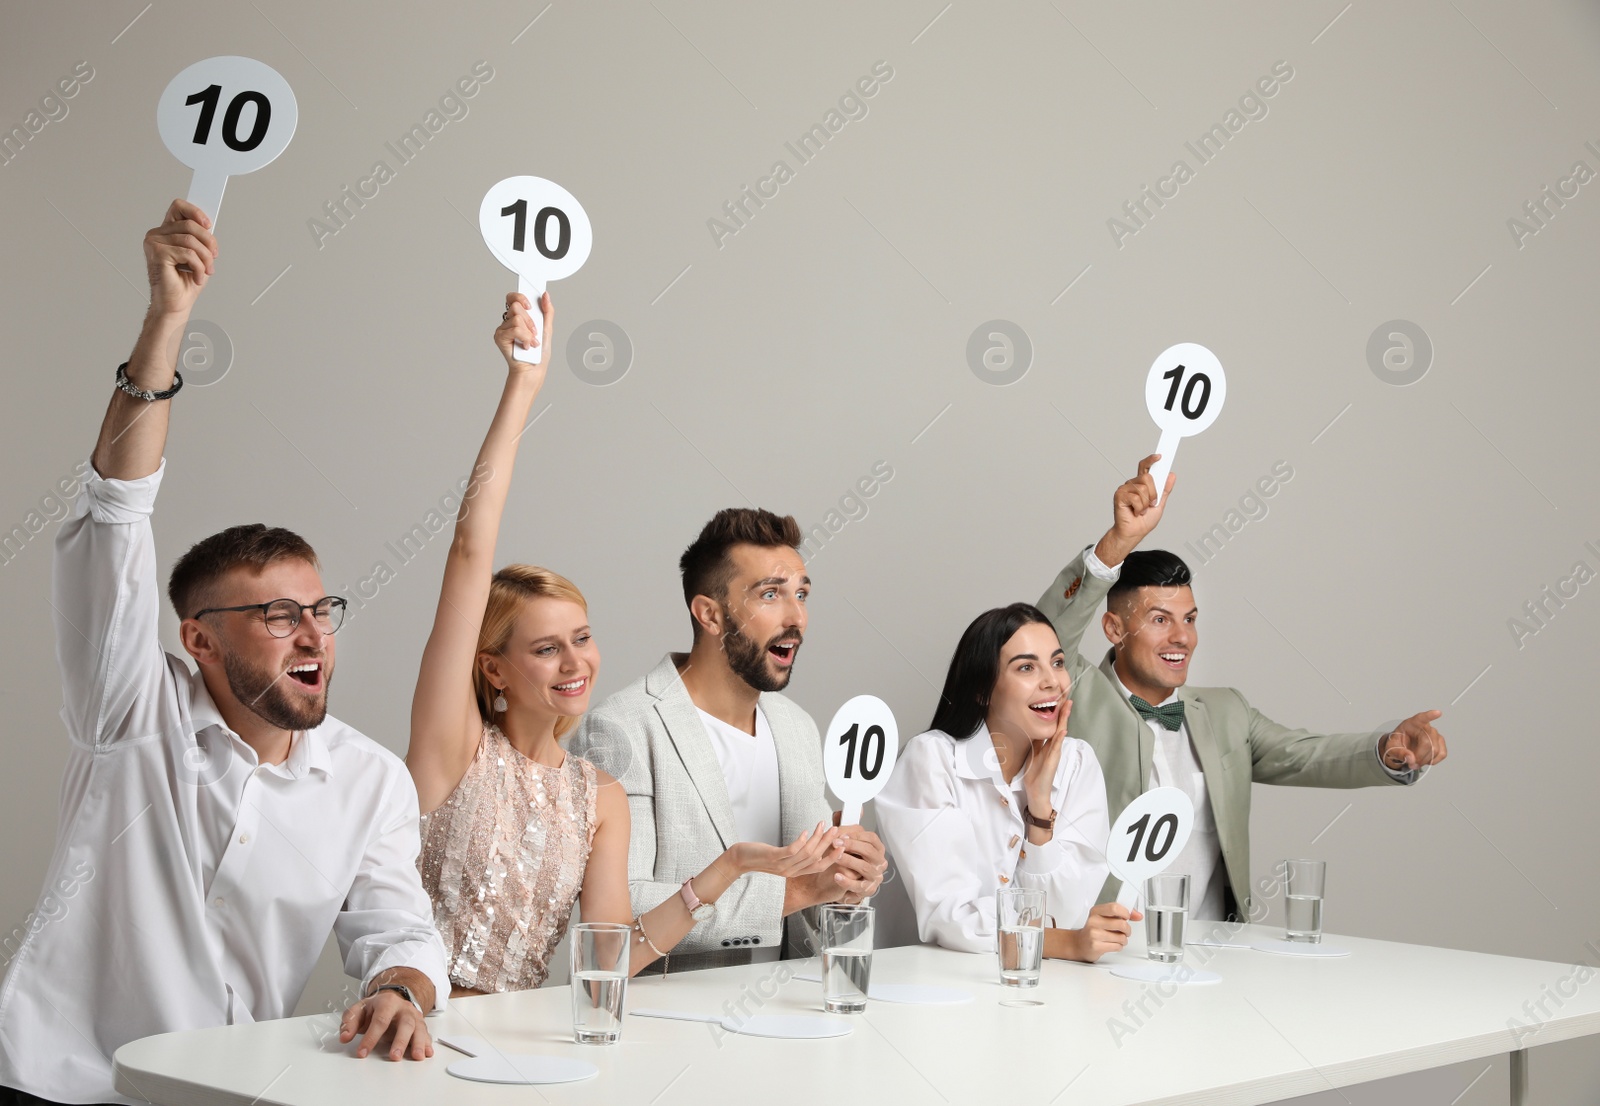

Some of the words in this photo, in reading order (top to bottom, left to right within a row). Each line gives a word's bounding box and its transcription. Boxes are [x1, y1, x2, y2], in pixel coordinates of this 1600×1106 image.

[184, 84, 272, 153] 10
[500, 199, 571, 260] 10
[1163, 364, 1212, 420] 10
[839, 723, 886, 781] 10
[1126, 813, 1179, 862] 10
